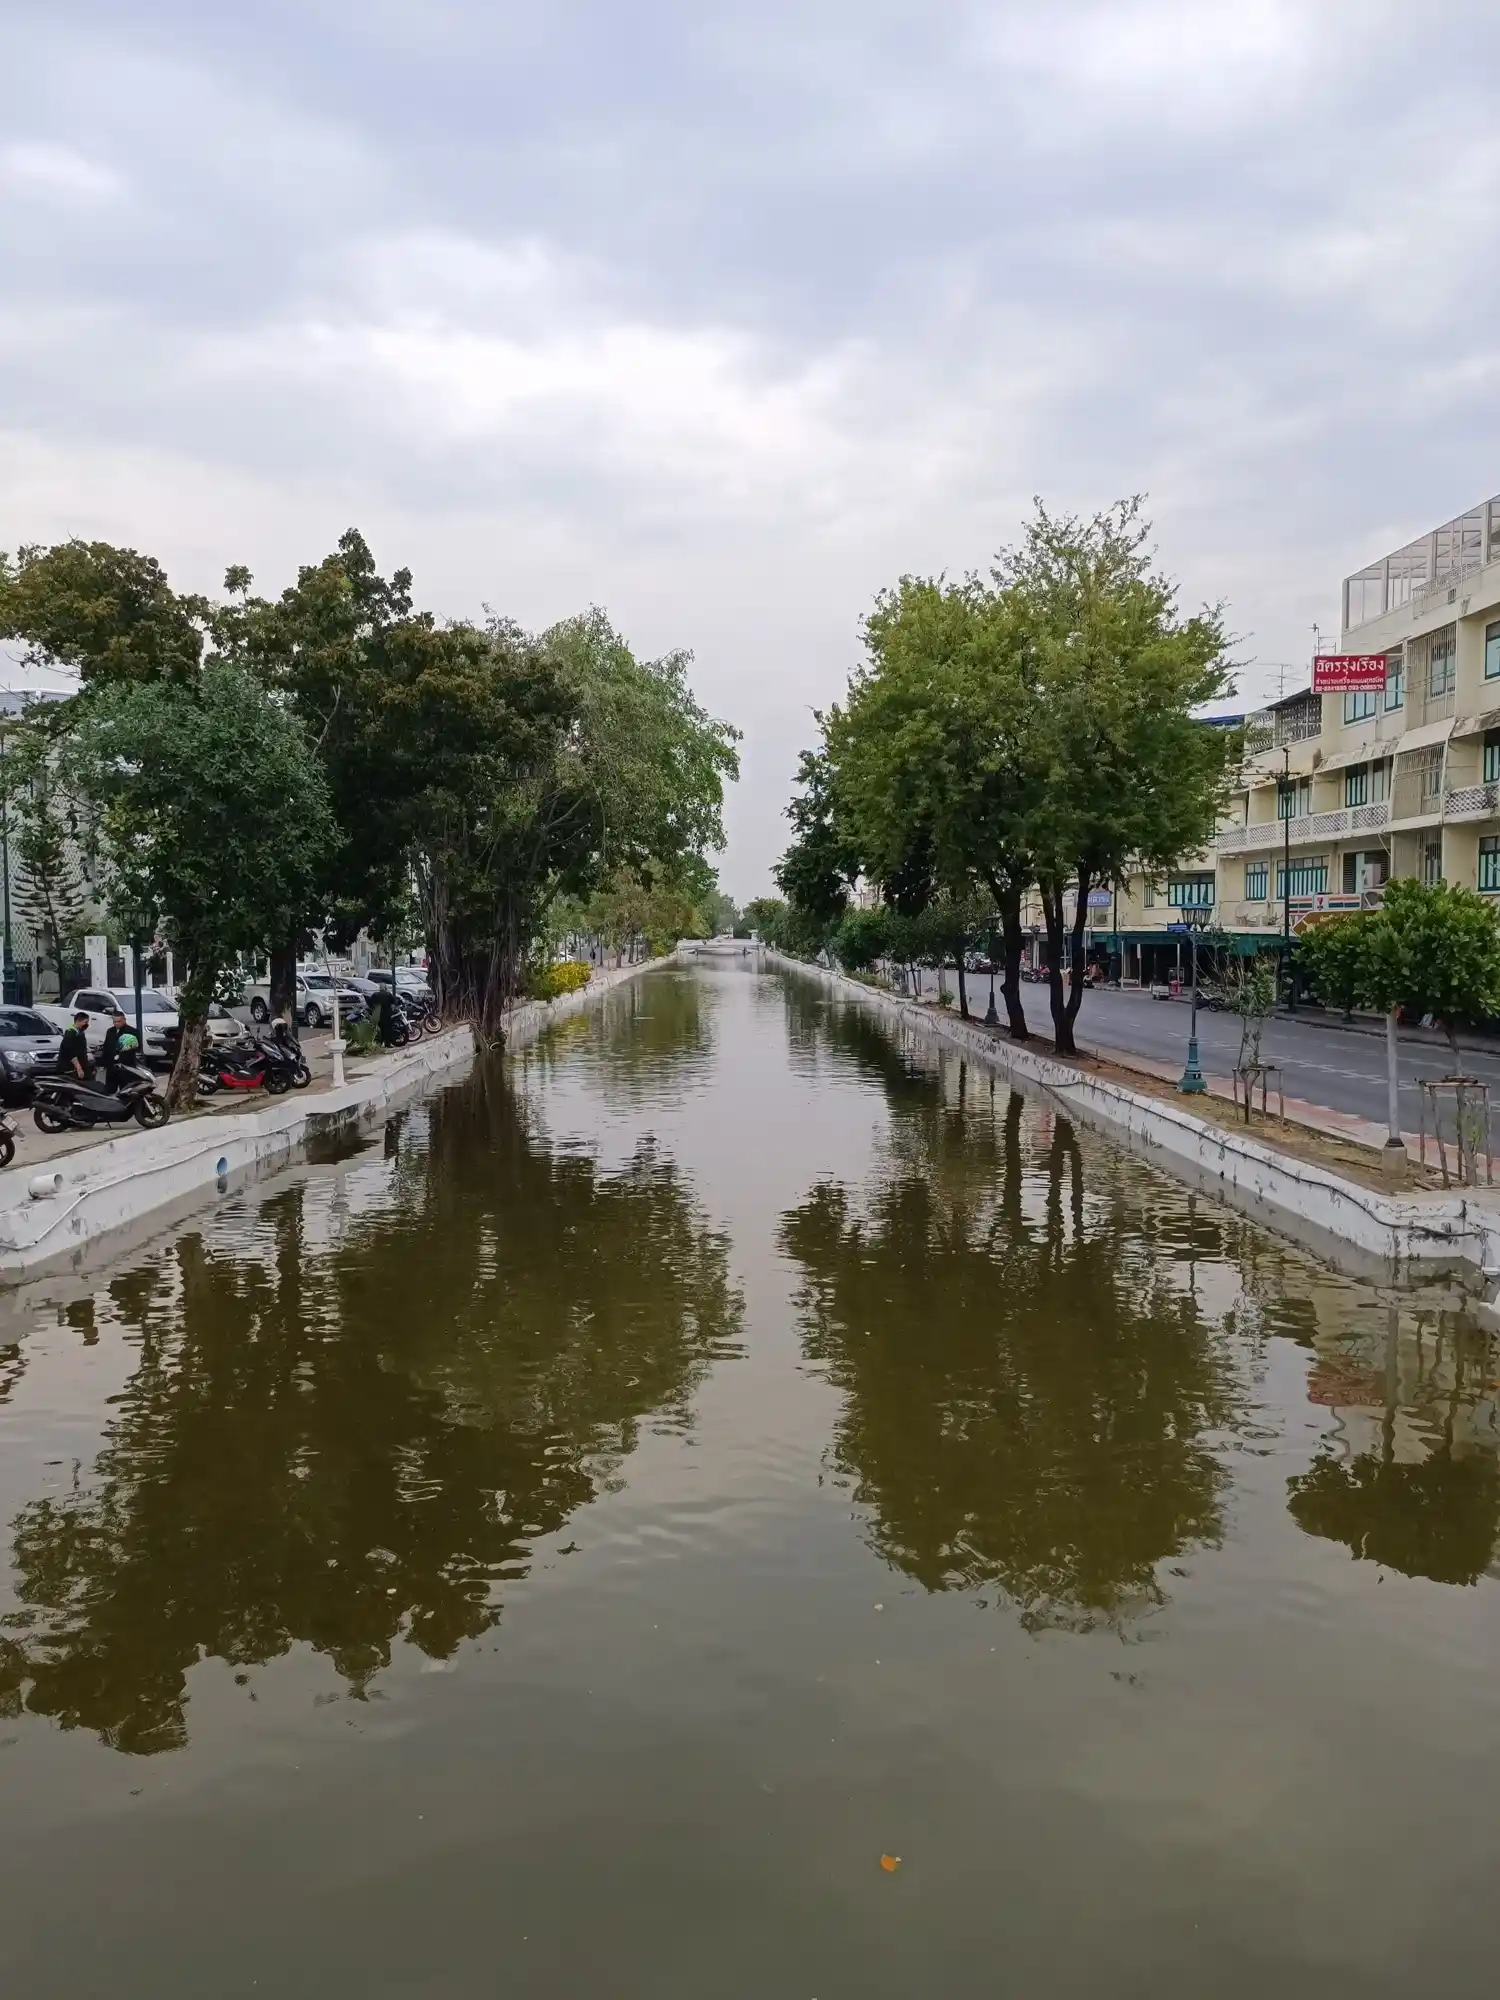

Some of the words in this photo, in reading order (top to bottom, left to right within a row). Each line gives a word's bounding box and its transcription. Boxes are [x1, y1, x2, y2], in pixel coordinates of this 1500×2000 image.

[1316, 657, 1384, 675] ฉัตรรุ่งเรือง
